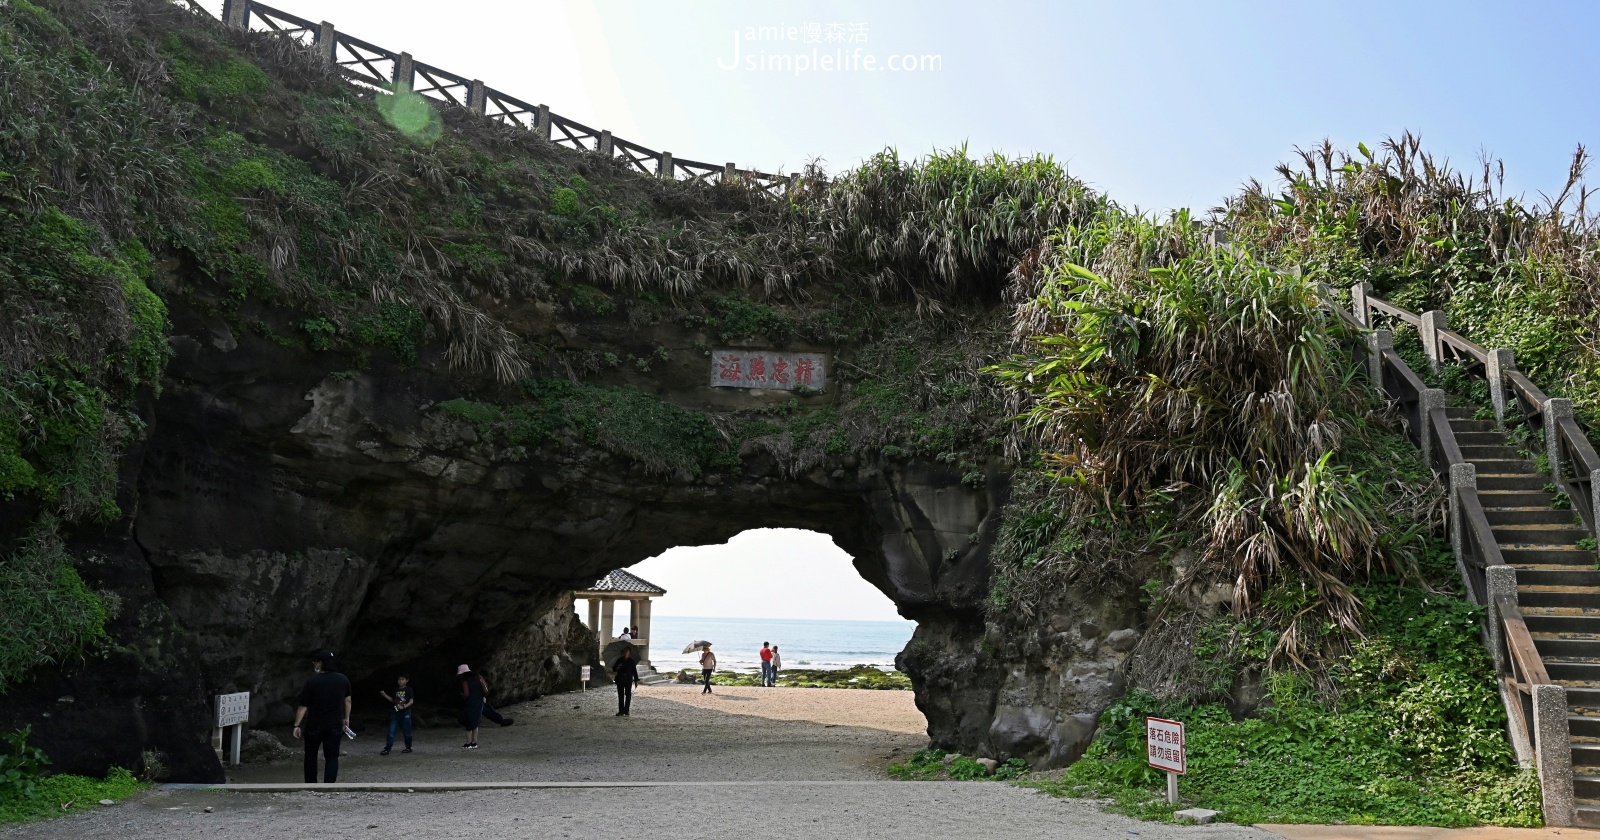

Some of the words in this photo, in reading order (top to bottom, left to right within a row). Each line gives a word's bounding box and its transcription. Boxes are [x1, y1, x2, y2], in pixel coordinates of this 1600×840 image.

[1149, 727, 1180, 745] 落石危險
[1150, 744, 1180, 763] 請勿逗留
